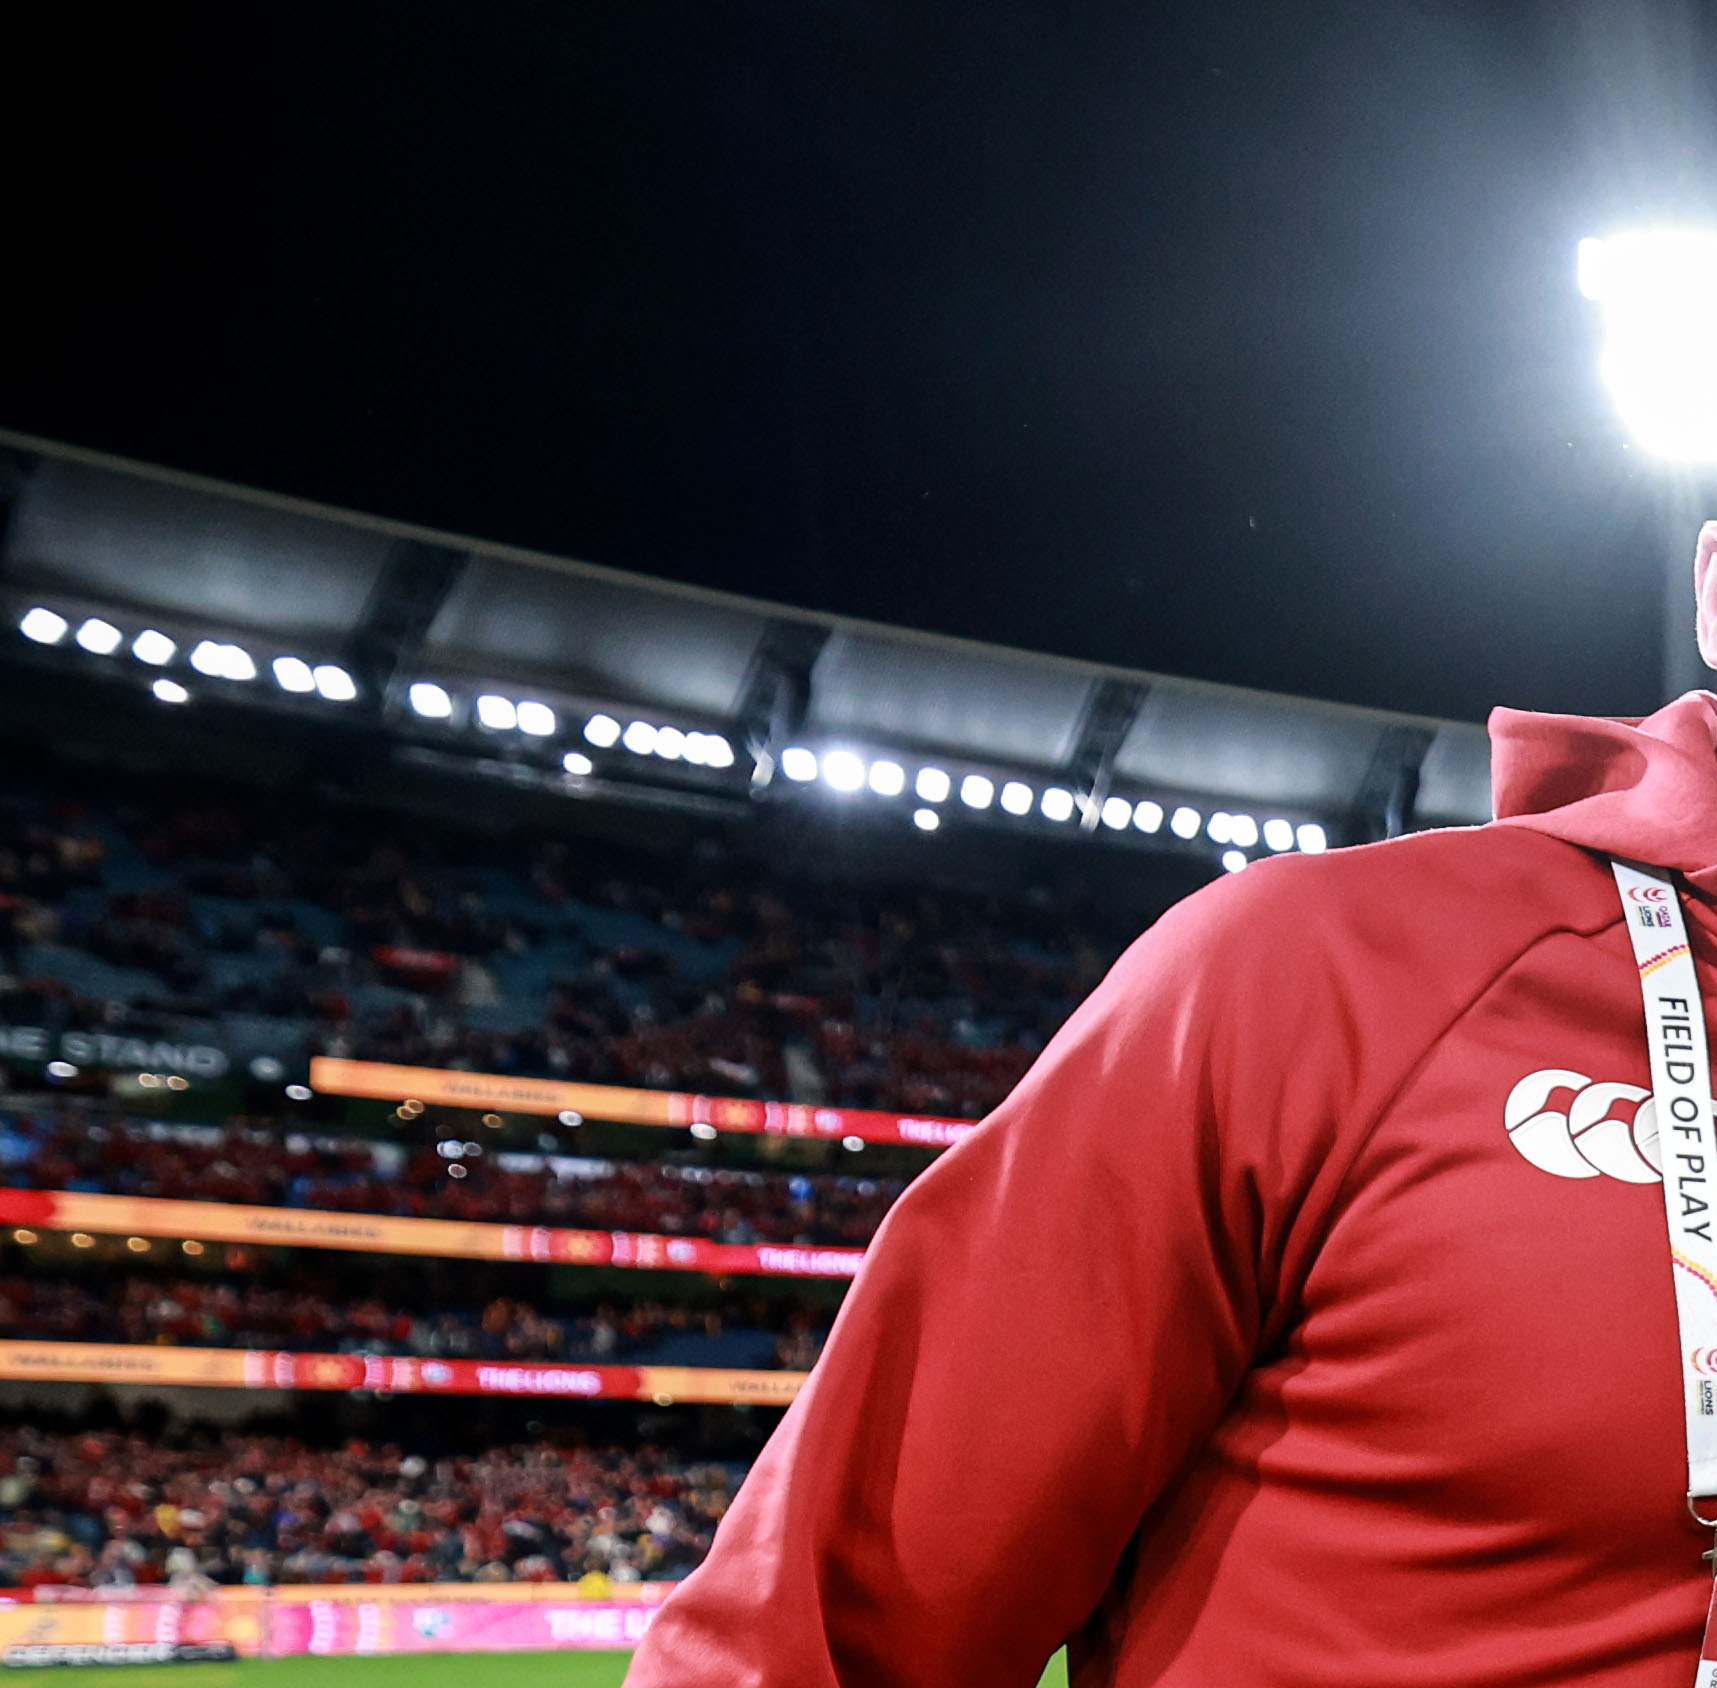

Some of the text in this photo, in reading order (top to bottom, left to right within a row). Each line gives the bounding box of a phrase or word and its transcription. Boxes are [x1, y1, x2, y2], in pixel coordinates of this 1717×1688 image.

[1658, 996, 1712, 1243] FIELD OF PLAY
[1703, 1380, 1714, 1416] LIONS
